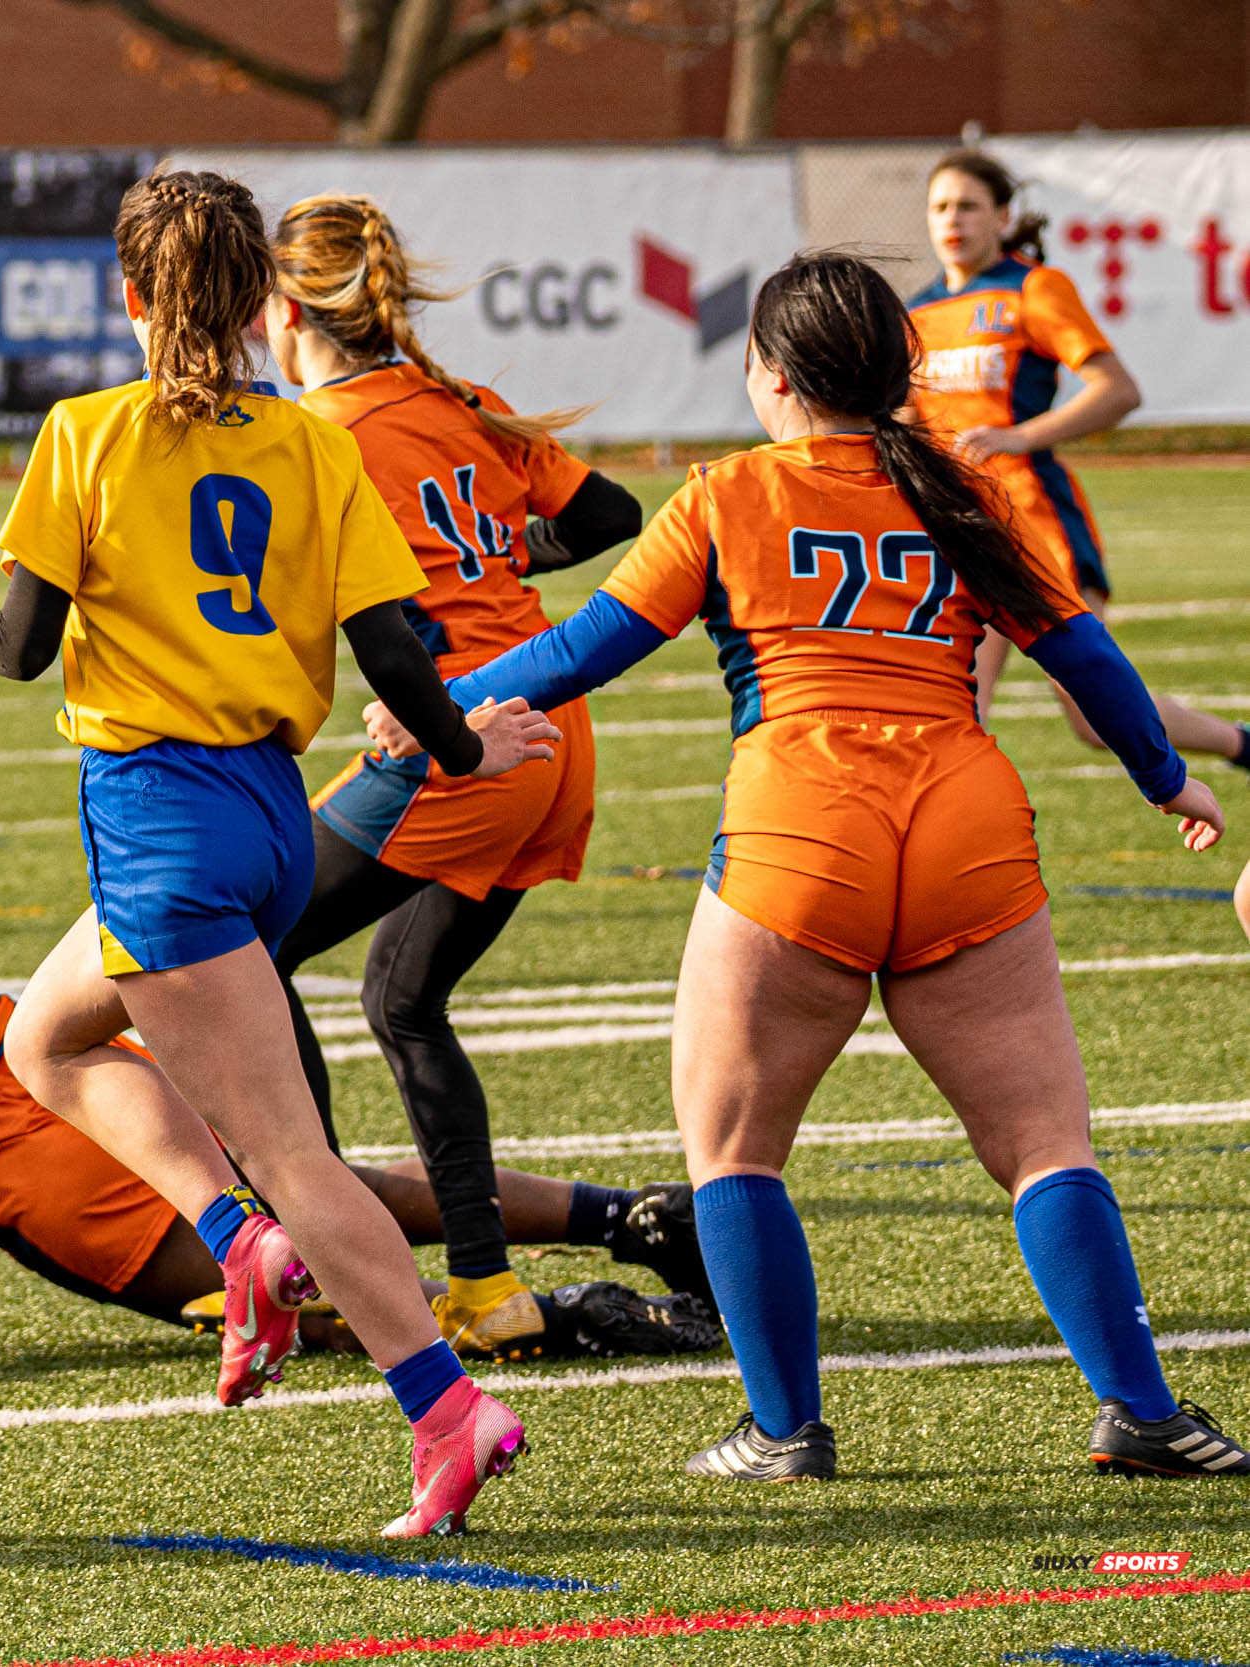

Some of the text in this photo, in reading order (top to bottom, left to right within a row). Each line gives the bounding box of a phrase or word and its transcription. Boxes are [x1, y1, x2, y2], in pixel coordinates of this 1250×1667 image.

[0, 257, 98, 341] GO!
[481, 261, 621, 333] CGC
[1190, 216, 1250, 320] t
[190, 473, 278, 636] 9
[781, 1440, 810, 1455] COPA
